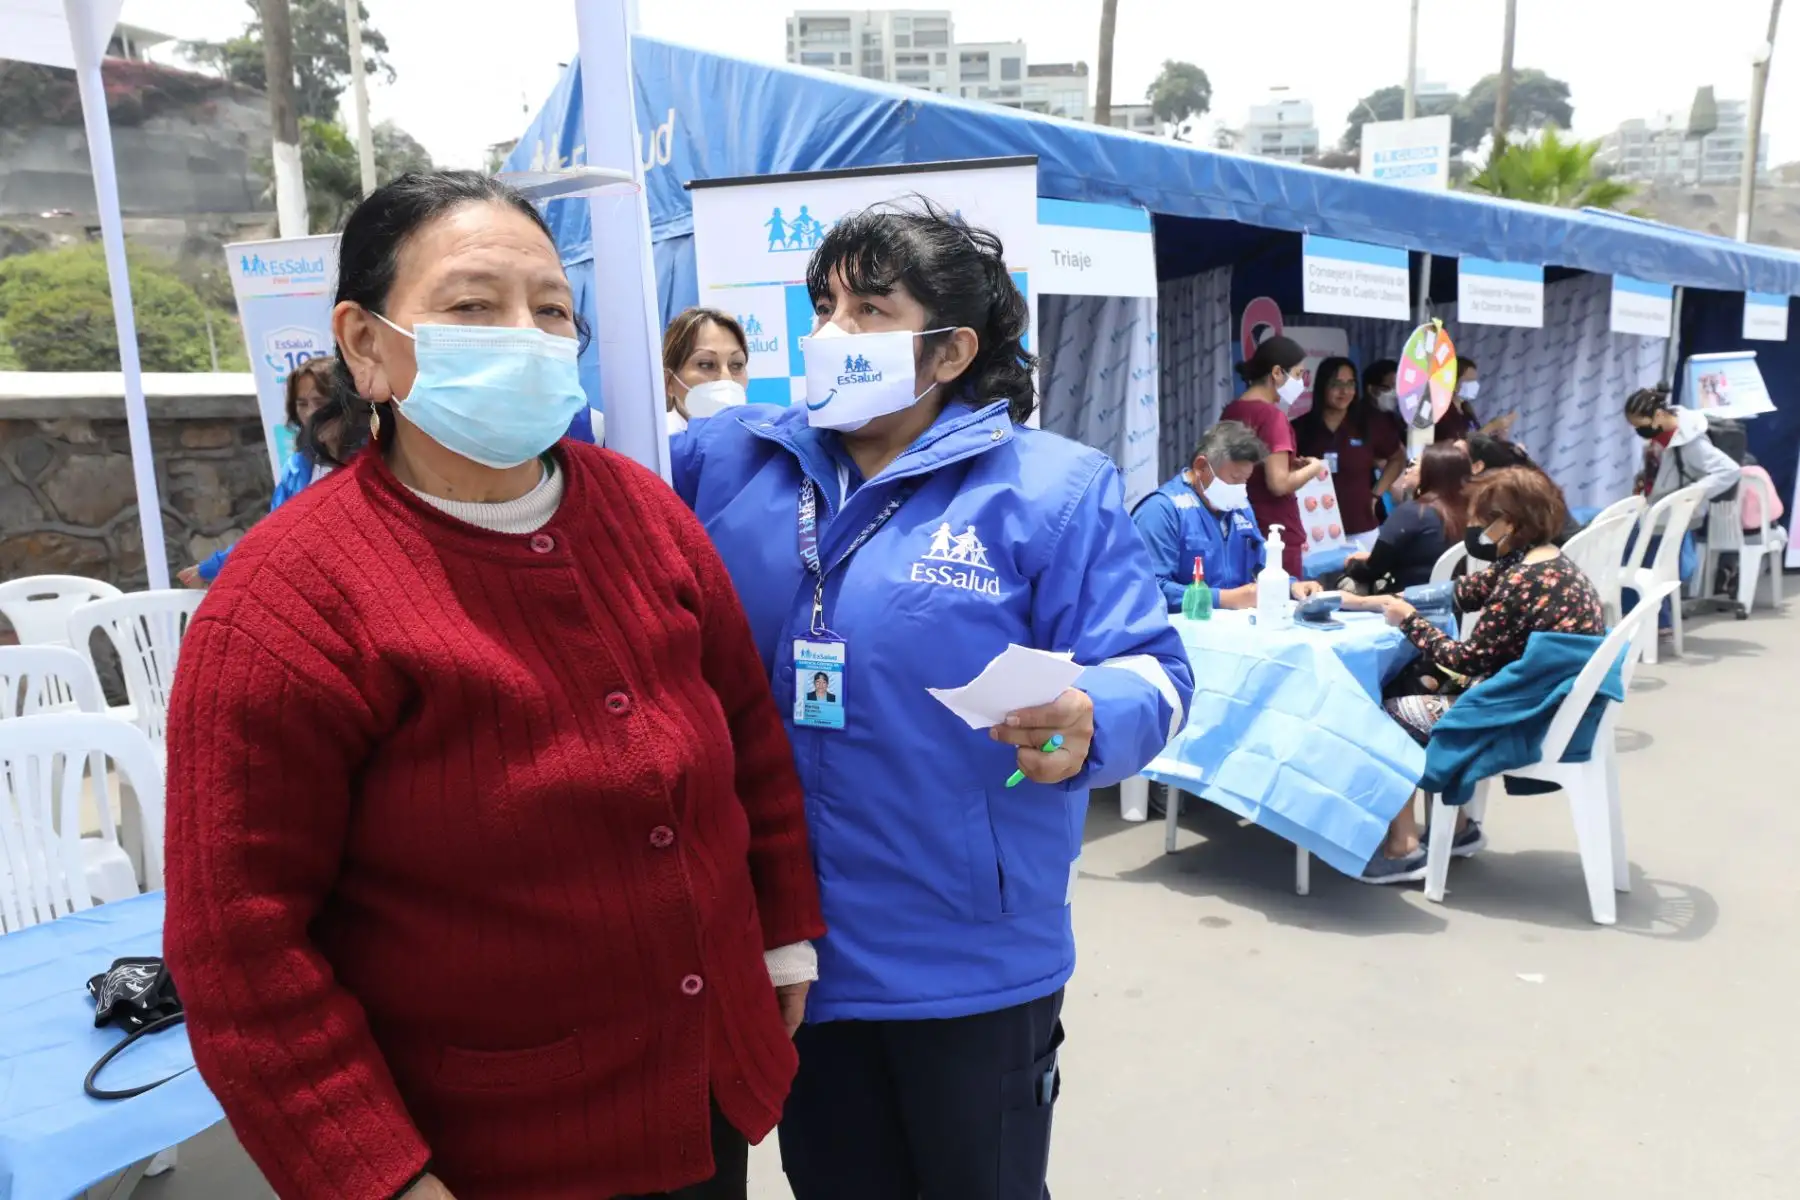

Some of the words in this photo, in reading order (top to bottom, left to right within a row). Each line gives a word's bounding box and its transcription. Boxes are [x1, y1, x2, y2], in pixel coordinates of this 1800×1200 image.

[270, 256, 324, 275] EsSalud
[1051, 249, 1092, 271] Triaje
[275, 340, 313, 350] EsSalud
[747, 336, 778, 352] alud
[837, 371, 882, 385] EsSalud
[911, 562, 999, 596] EsSalud
